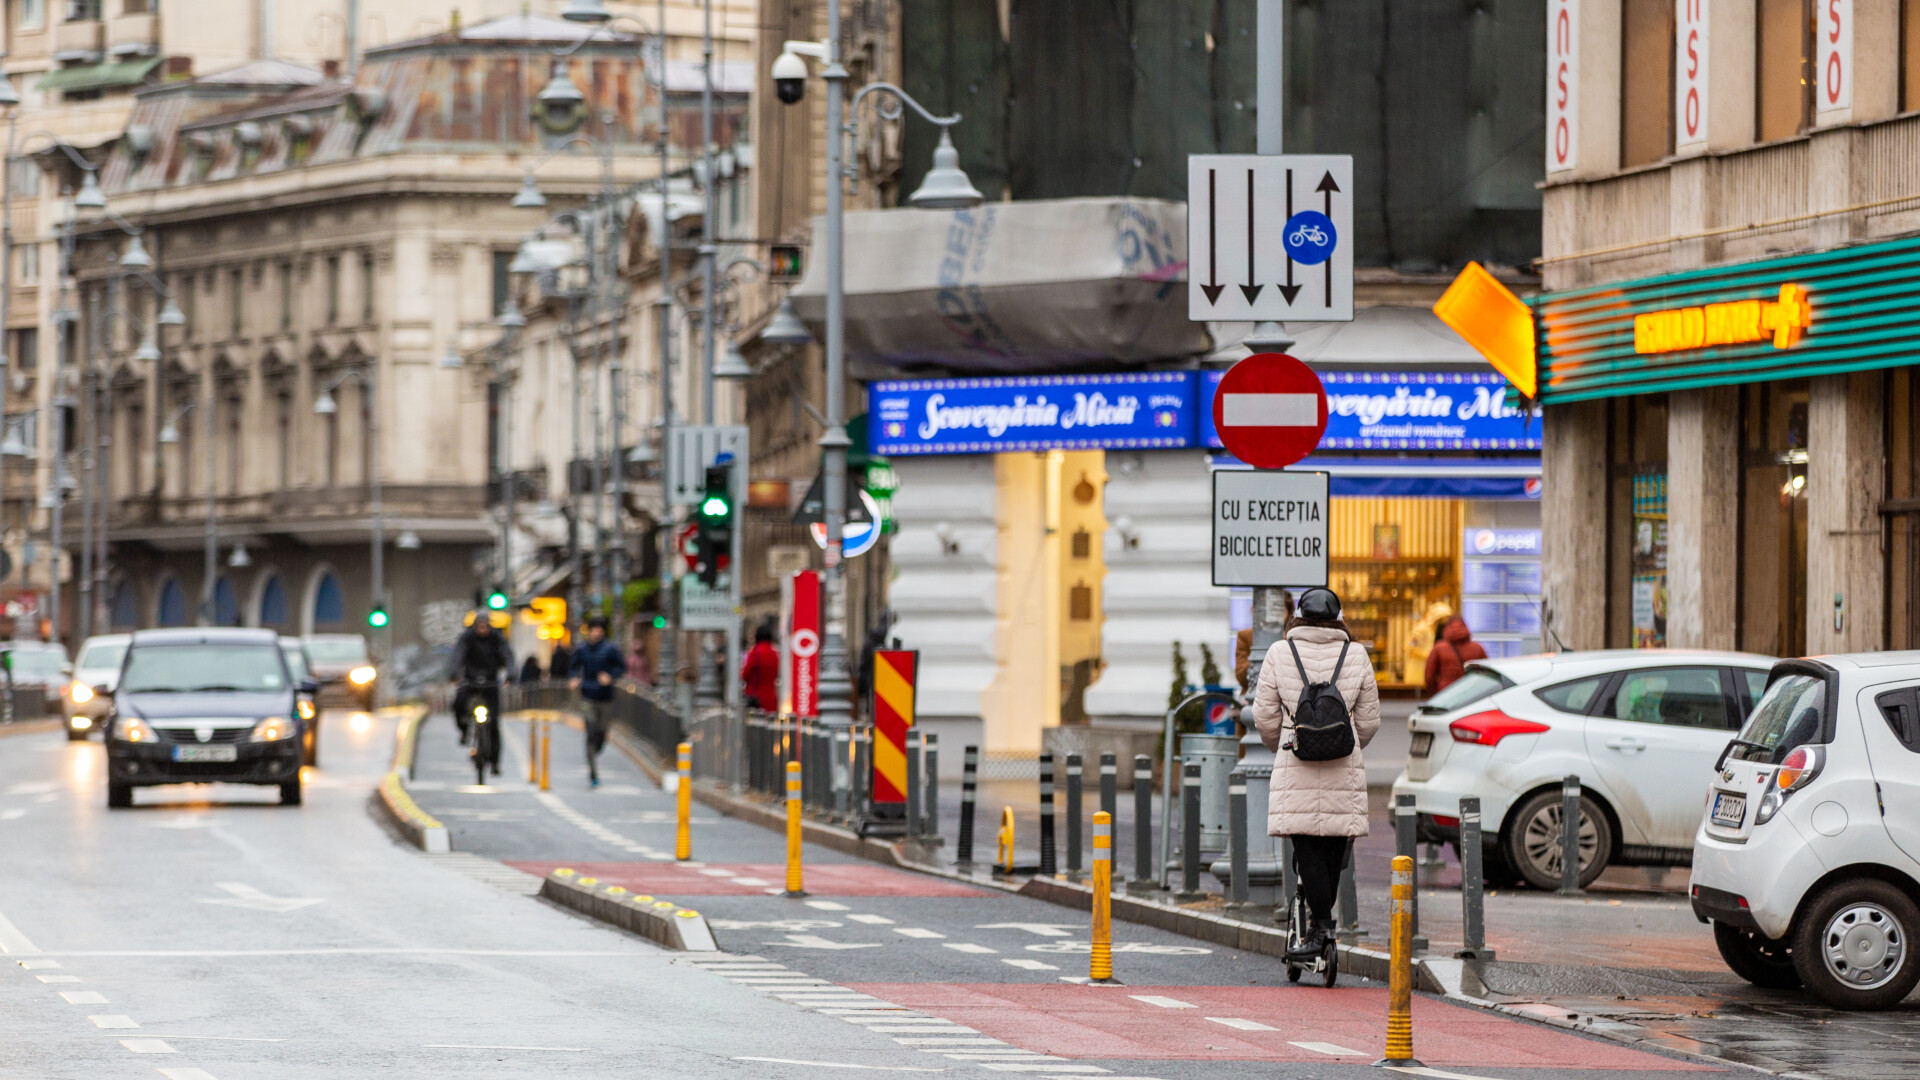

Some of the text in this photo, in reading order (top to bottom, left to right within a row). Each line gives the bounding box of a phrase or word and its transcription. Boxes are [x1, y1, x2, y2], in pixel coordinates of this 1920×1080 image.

[1556, 0, 1570, 164] nso
[1327, 386, 1452, 425] vergăria
[1221, 500, 1320, 524] CU EXCEPȚIA
[1220, 536, 1321, 557] BICICLETELOR
